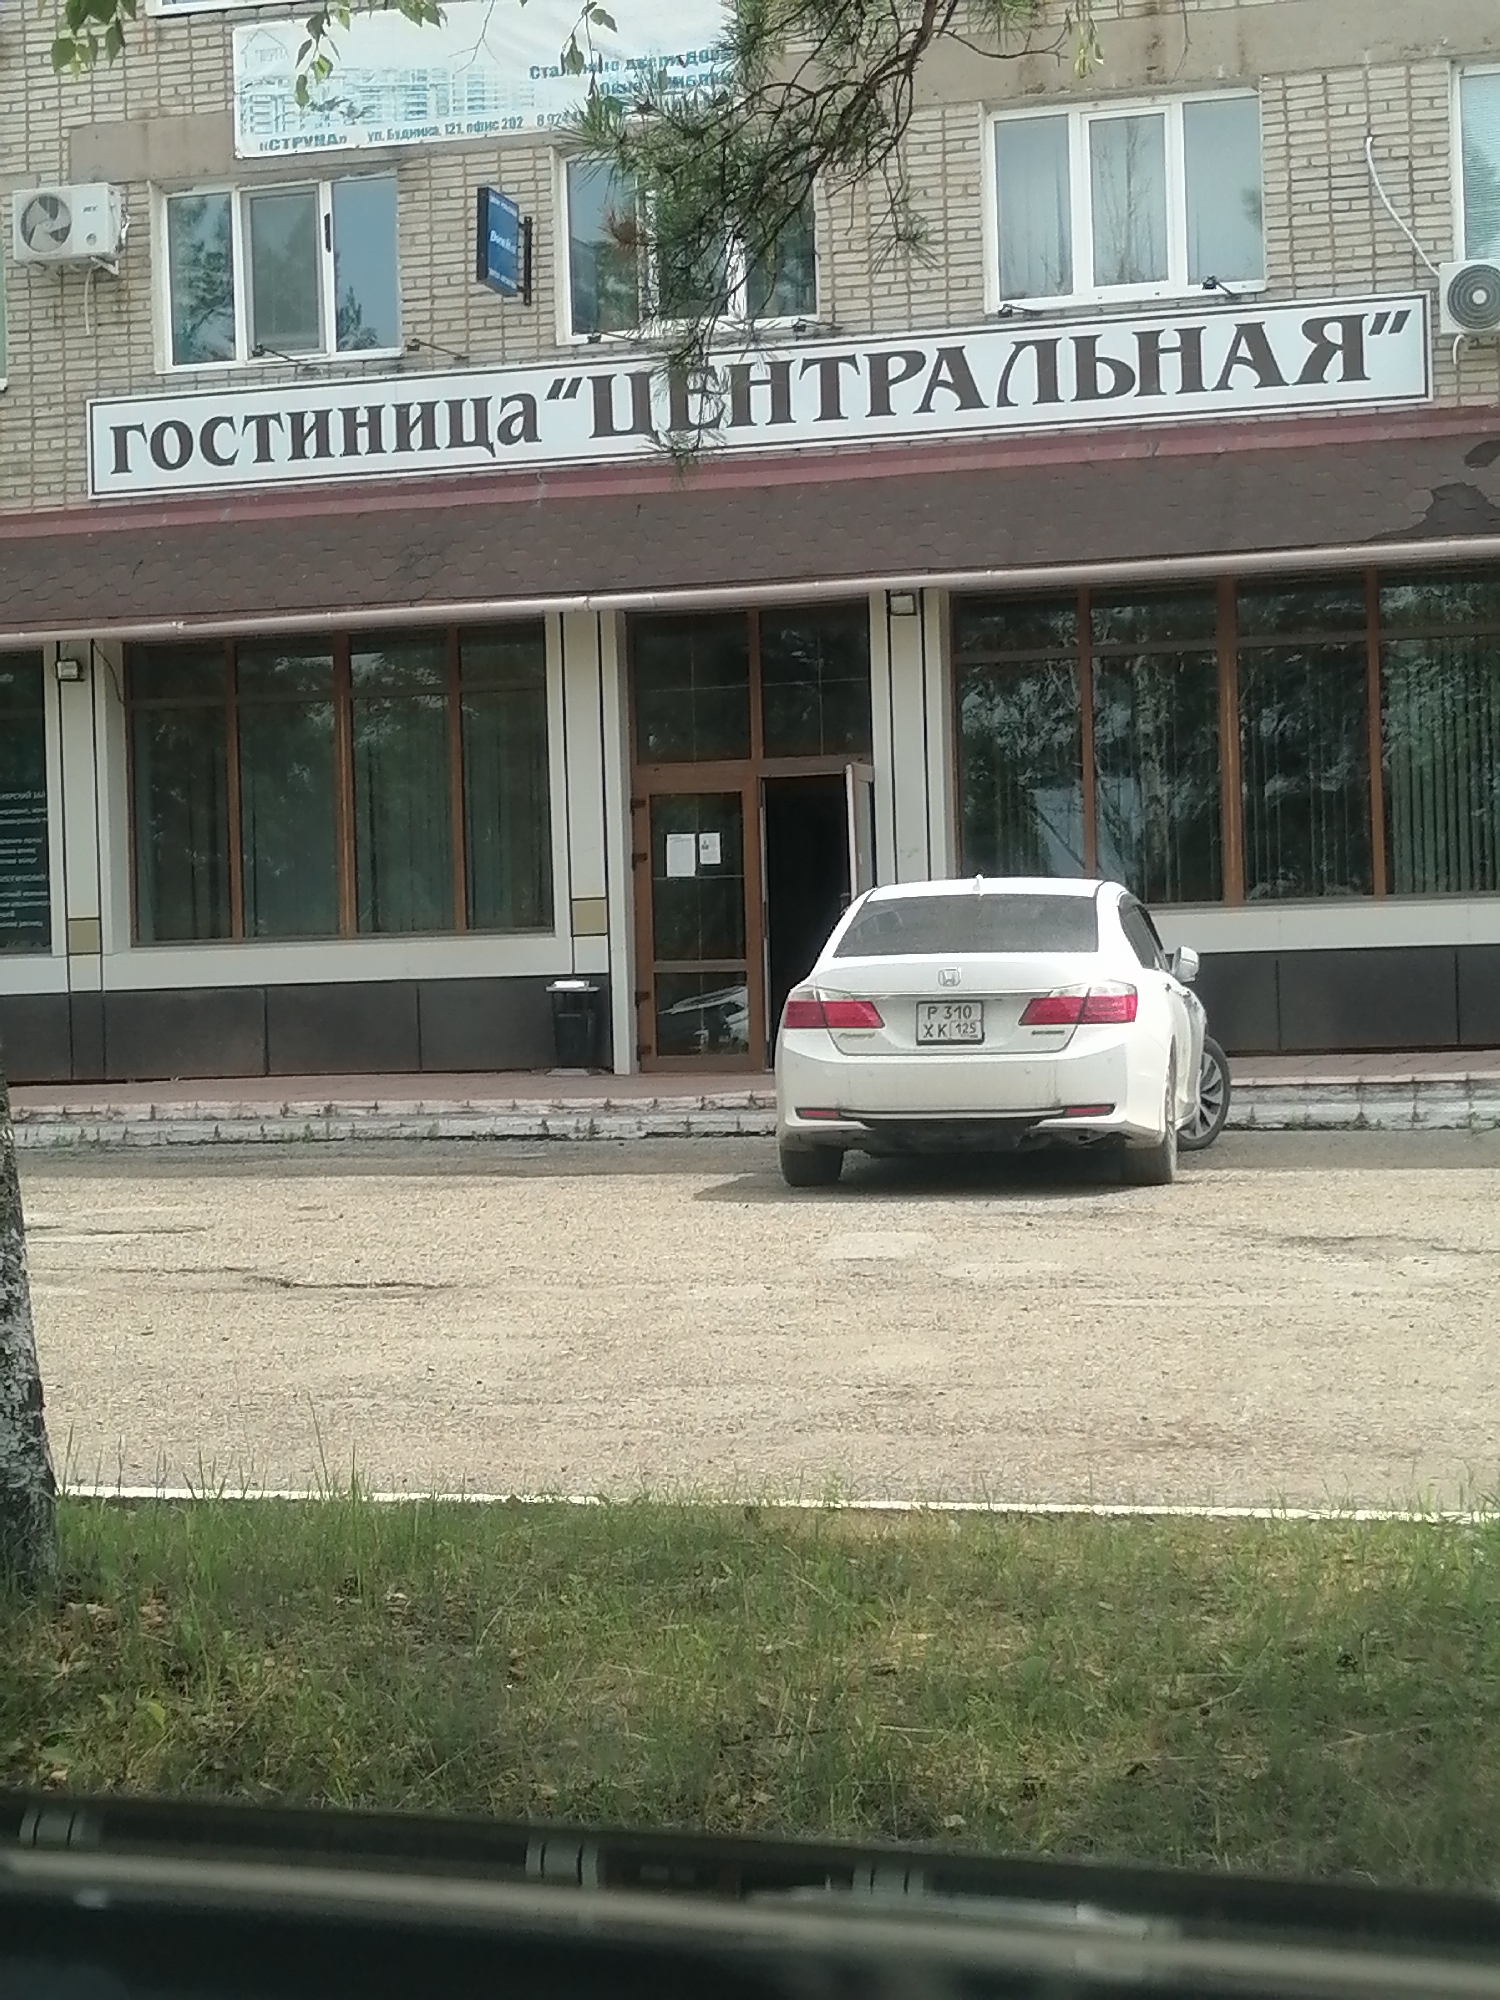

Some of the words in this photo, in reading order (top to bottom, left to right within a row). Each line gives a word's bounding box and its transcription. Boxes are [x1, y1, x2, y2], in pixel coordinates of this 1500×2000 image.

[501, 115, 524, 130] 202
[537, 113, 545, 128] 8
[943, 1004, 973, 1020] 310
[954, 1022, 978, 1035] 125
